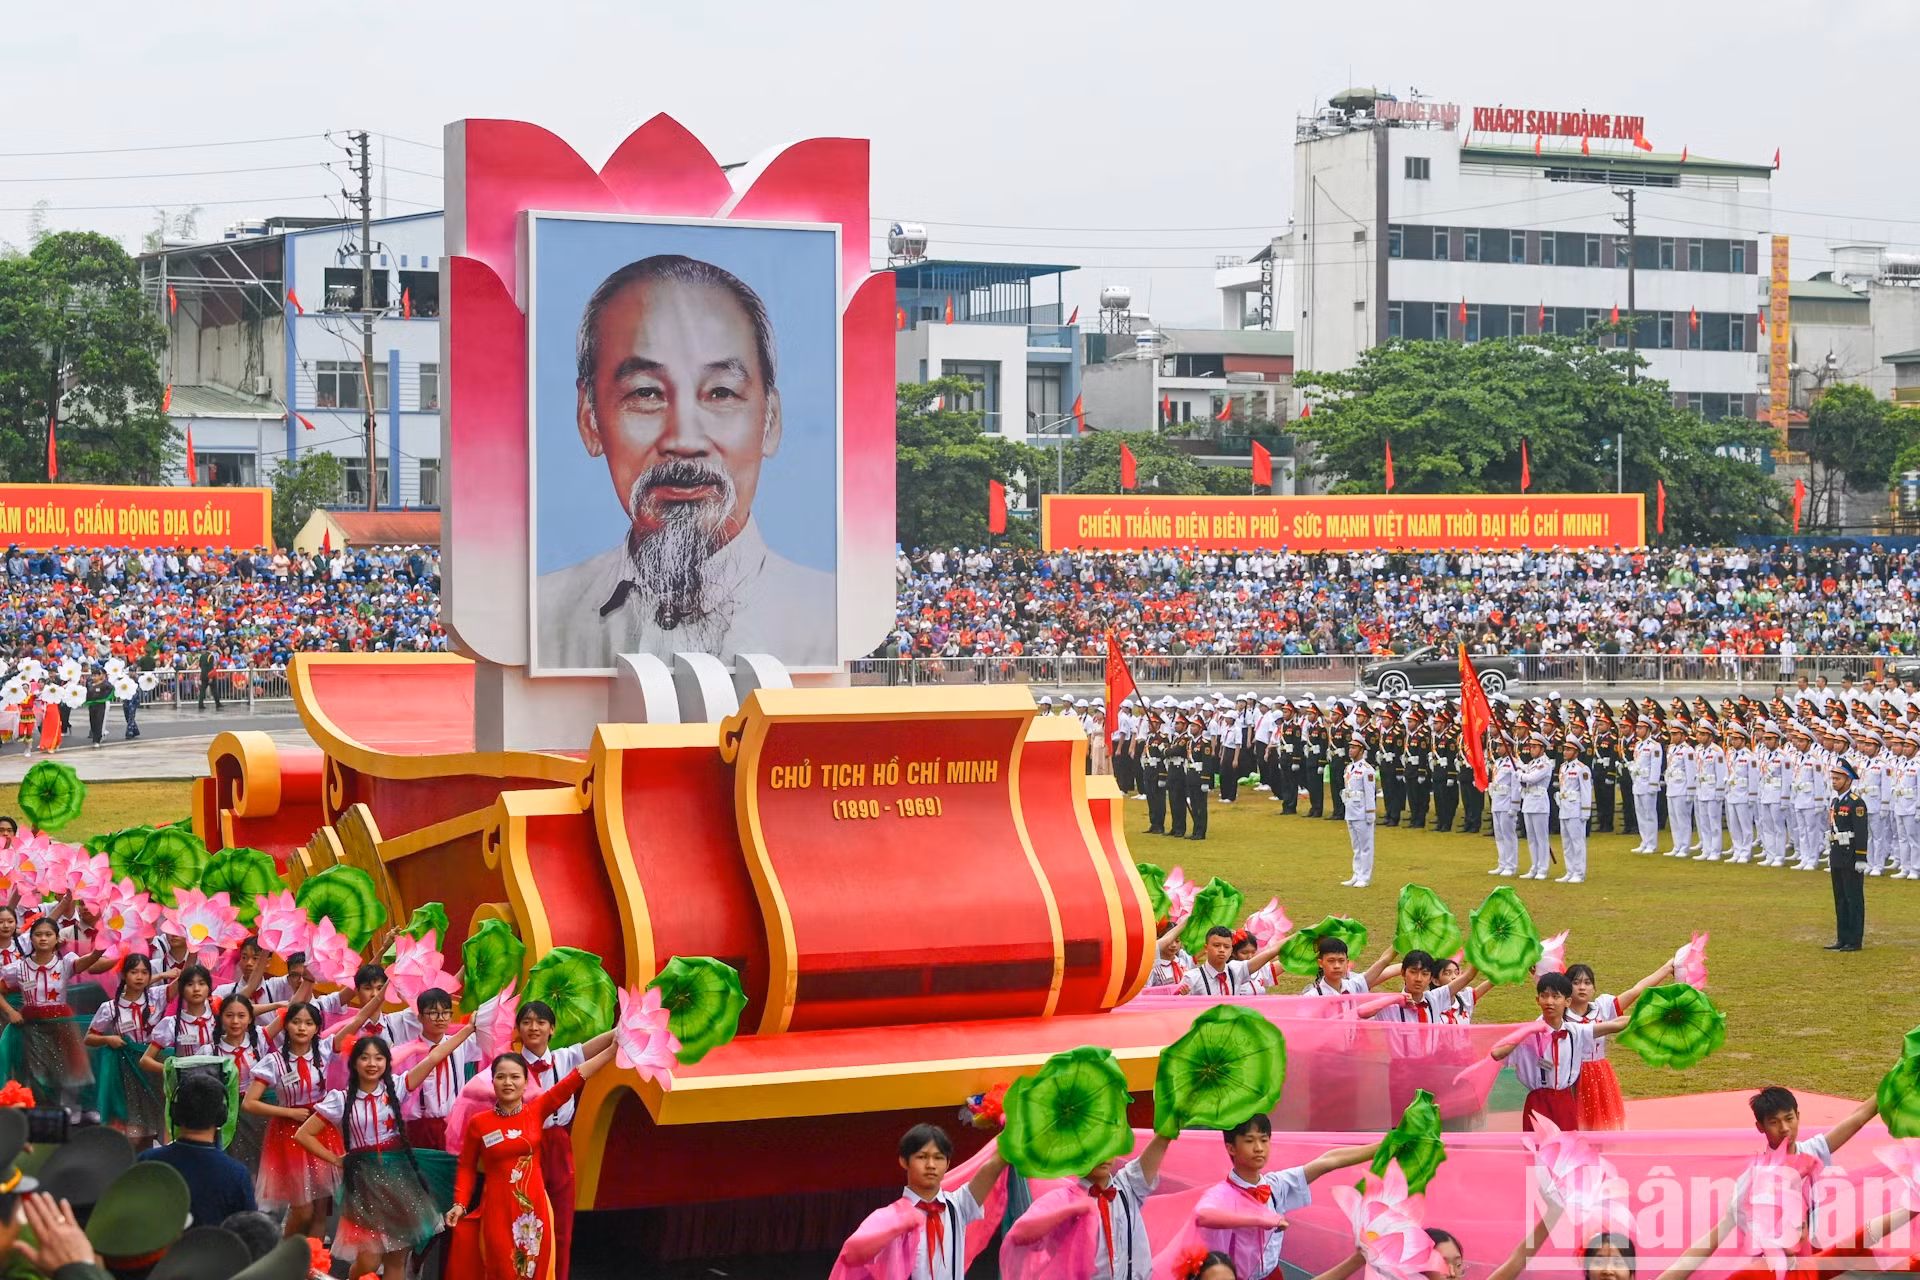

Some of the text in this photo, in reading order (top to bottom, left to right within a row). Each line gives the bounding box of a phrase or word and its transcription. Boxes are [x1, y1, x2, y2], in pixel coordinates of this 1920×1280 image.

[1429, 103, 1460, 123] ANH
[1473, 103, 1524, 133] KHÁCH
[1561, 108, 1610, 138] HOÀNG
[1612, 115, 1644, 140] ANH
[26, 501, 70, 537] CHÂU,
[74, 499, 115, 535] CHẤN
[118, 503, 160, 541] ĐỘNG
[163, 509, 189, 541] ĐỊA
[1078, 507, 1122, 539] CHIẾN
[1125, 506, 1172, 539] THẮNG
[1175, 511, 1209, 544] ĐIỆN
[1213, 510, 1247, 539] BIÊN
[1251, 507, 1280, 539] PHỦ
[1293, 510, 1323, 539] SỨC
[1326, 514, 1370, 543] MẠNH
[1373, 509, 1404, 543] VIỆT
[1408, 513, 1442, 537] NAM
[1445, 508, 1478, 537] THỜI
[1481, 513, 1506, 543] ĐẠI
[1510, 506, 1530, 537] HỒ
[1533, 508, 1559, 537] CHÍ
[770, 755, 999, 791] CHỦ TỊCH HỒ CHÍ MINH
[832, 799, 880, 820] (1890
[896, 796, 943, 818] 1969)
